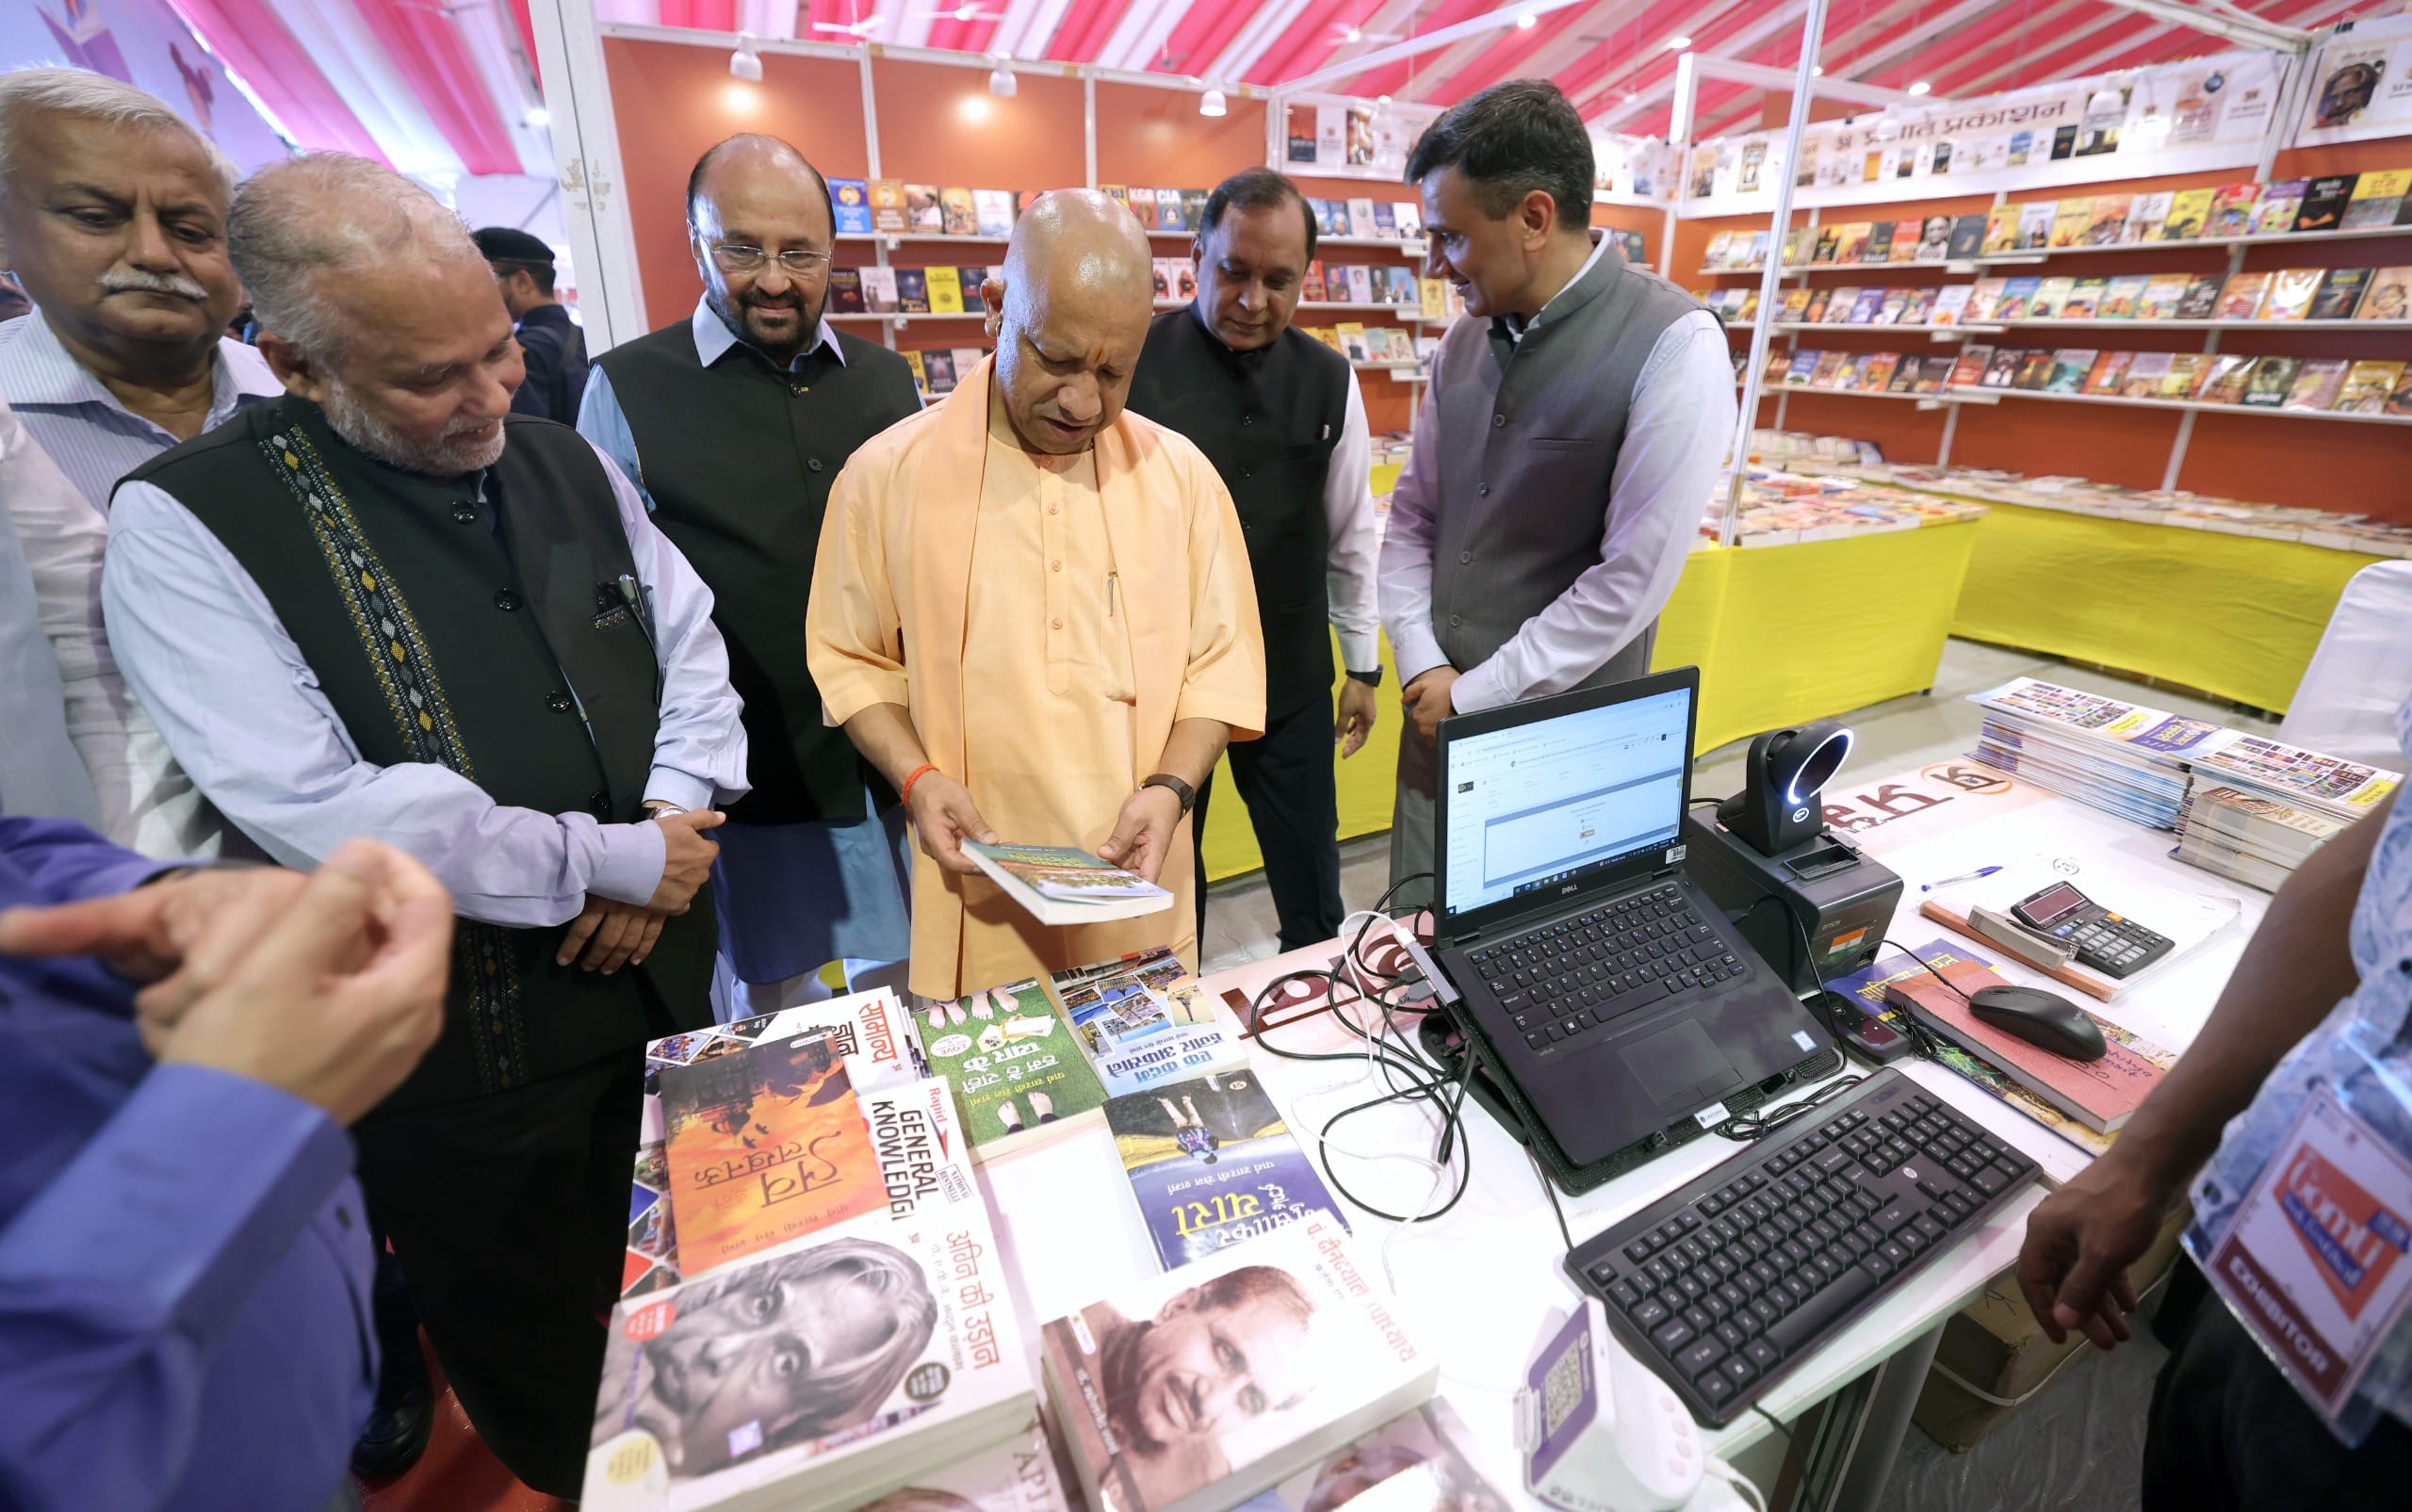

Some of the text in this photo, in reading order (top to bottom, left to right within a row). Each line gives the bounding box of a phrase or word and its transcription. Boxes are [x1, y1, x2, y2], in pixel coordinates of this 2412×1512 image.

[1944, 101, 2067, 134] प्रकाशन
[1129, 188, 1154, 201] KGB
[1156, 189, 1181, 203] CIA
[1561, 883, 1578, 895] DELL
[829, 1020, 859, 1057] ज्ञान
[858, 1000, 898, 1064] सामान्य
[938, 1043, 966, 1055] LOVE
[963, 1042, 1040, 1073] प्यार के
[1105, 1031, 1225, 1079] हजार अफसाने
[1134, 1049, 1214, 1082] एक कदम
[961, 1054, 1060, 1095] हम हैं राही
[929, 1087, 948, 1124] Rapid
[695, 1141, 807, 1191] लखनऊ
[760, 1130, 842, 1208] लव
[871, 1101, 916, 1222] KNOWLEDG
[900, 1109, 938, 1199] GENERAL
[937, 1170, 960, 1203] BESTSELLE
[1166, 1161, 1276, 1196] पार्थ सारथी सेन शर्मा
[1317, 1239, 1369, 1298] दीनदयाल
[945, 1230, 1002, 1371] अग्नि की उड़ान
[2229, 1255, 2330, 1375] EXHIBITOR
